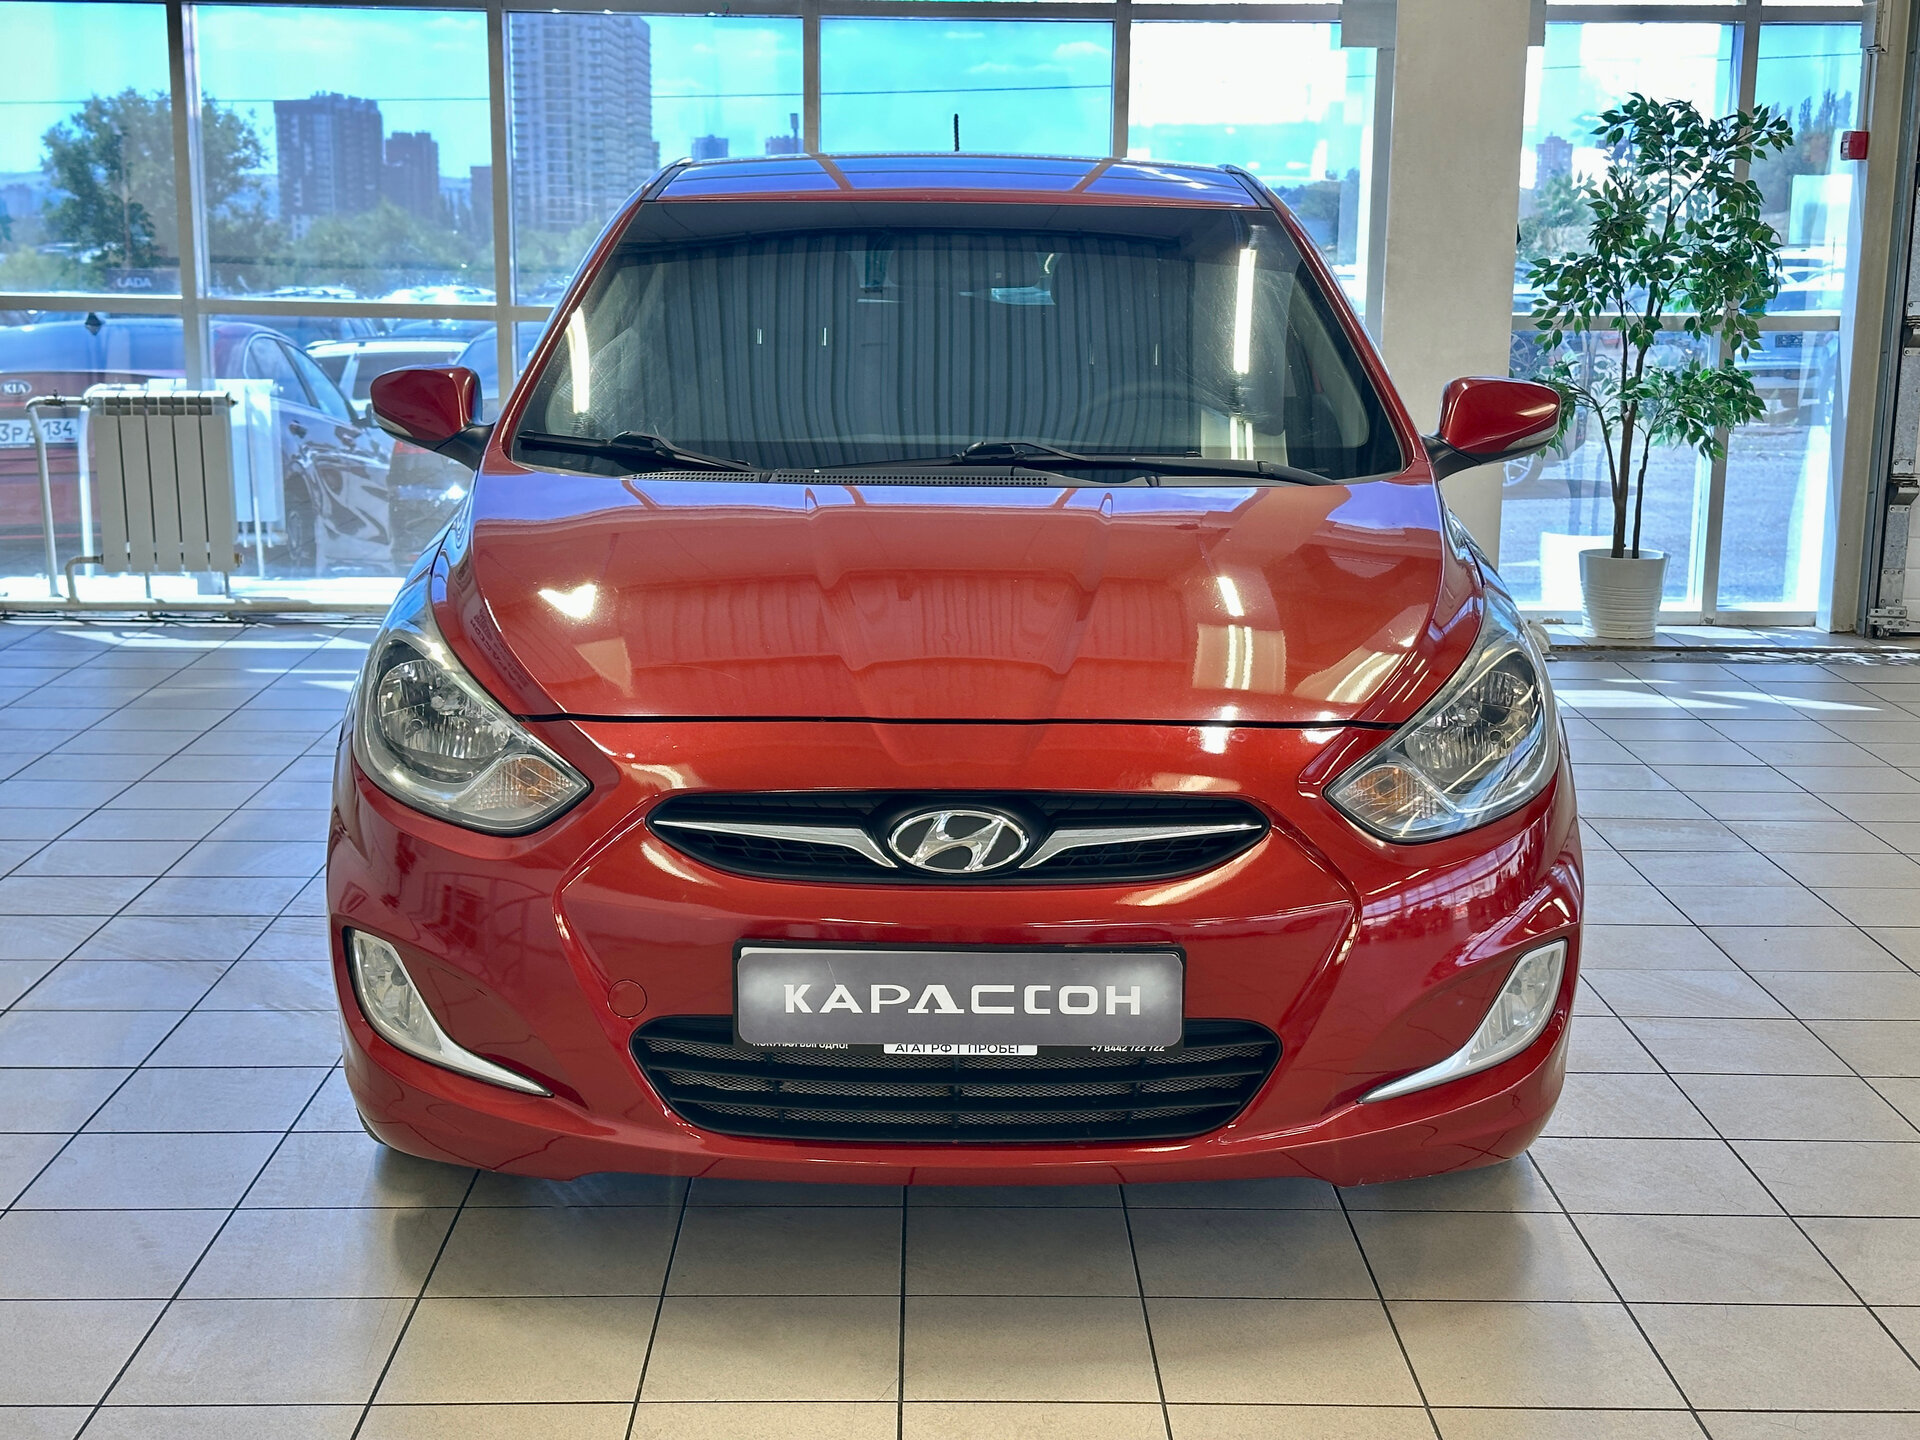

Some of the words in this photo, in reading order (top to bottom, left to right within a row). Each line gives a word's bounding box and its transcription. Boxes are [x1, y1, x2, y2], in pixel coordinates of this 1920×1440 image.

[116, 277, 152, 288] LADA
[3, 383, 26, 393] KIA
[43, 421, 72, 435] 134
[783, 983, 1141, 1015] КАРАССОН
